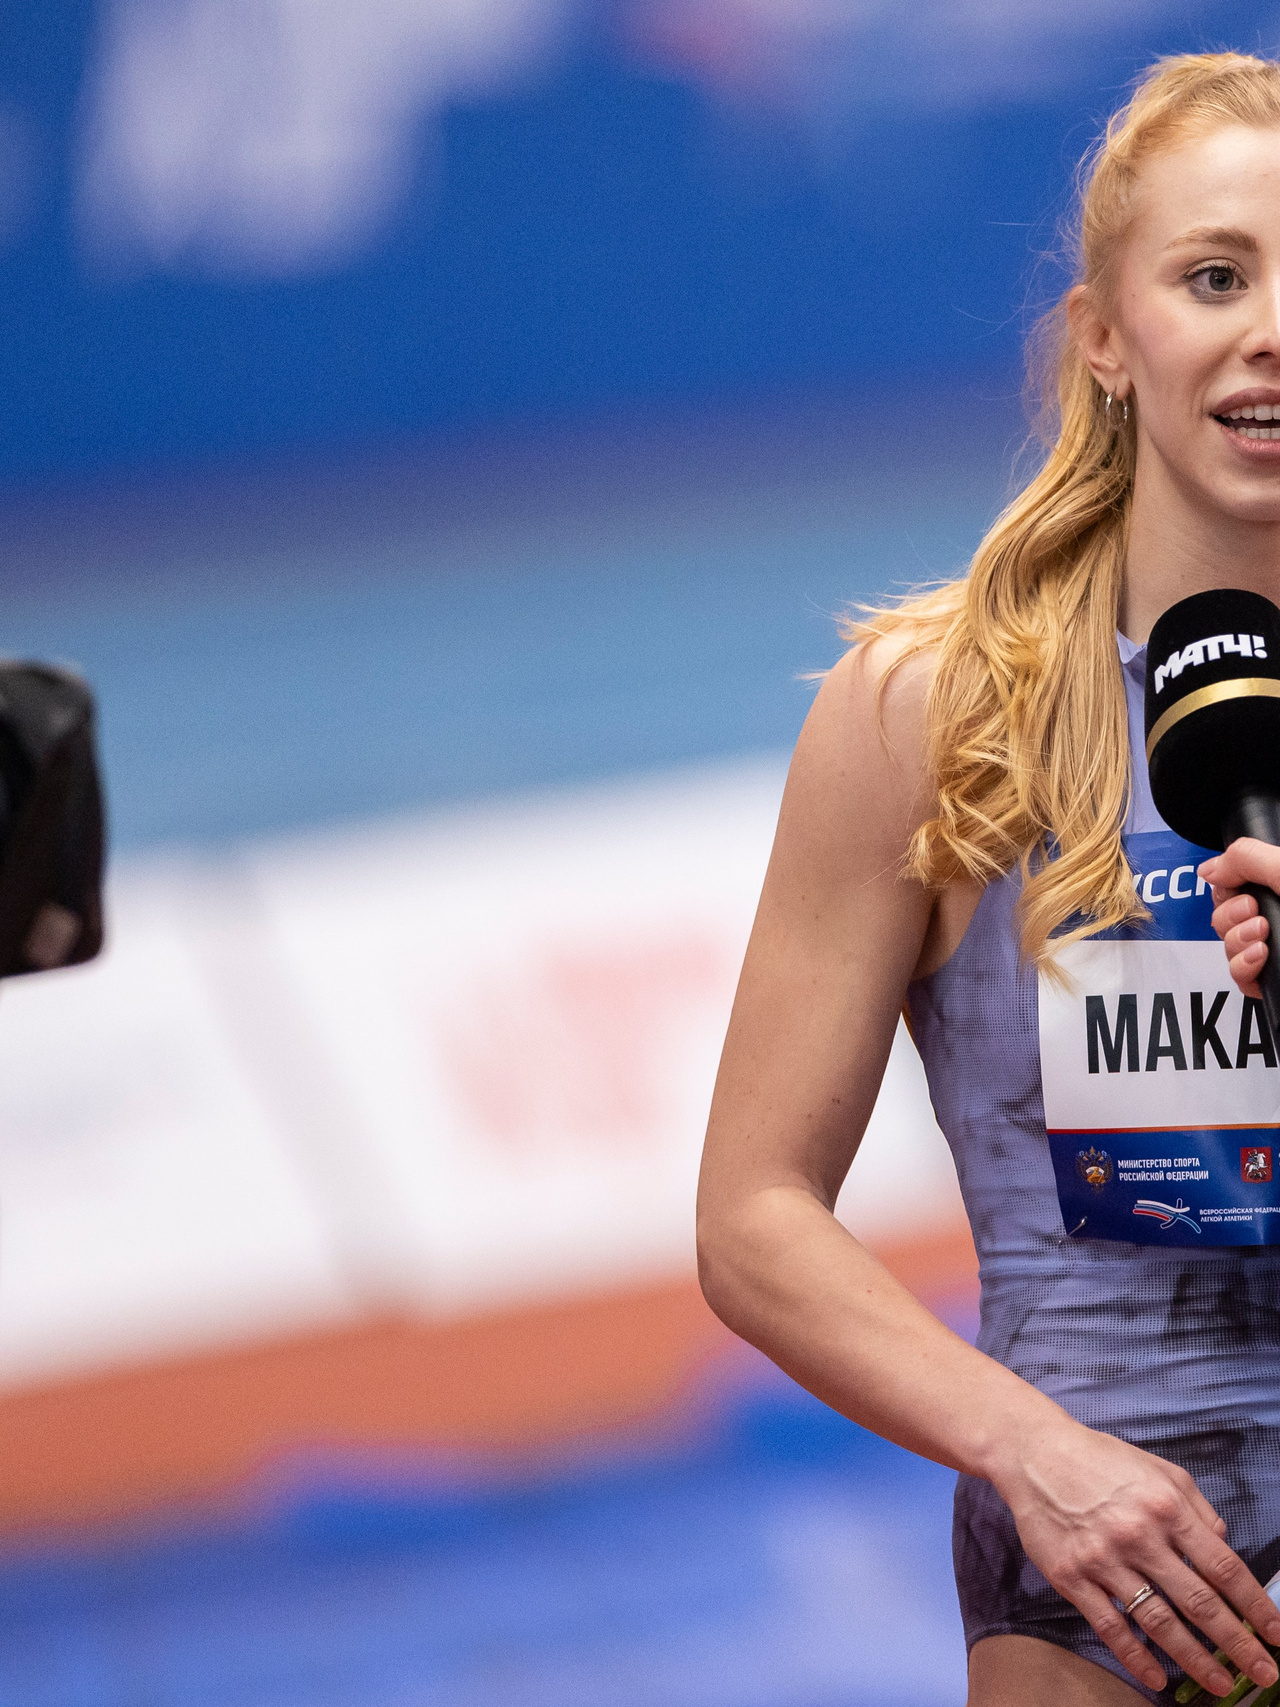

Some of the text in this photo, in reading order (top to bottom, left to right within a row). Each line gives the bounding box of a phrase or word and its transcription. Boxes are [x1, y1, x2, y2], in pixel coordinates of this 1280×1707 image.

[1154, 633, 1268, 695] МАТЧ!
[1117, 1157, 1200, 1169] МИНИСТЕРСТВО СПОРТА
[1118, 1170, 1209, 1182] РОССИЙСКОЙ ФЕДЕРАЦИИ
[1199, 1206, 1253, 1216] ВСЕРОССИЙСКАЯ
[1200, 1214, 1253, 1223] ЛЕГКОЙ АТЛЕТИКИ
